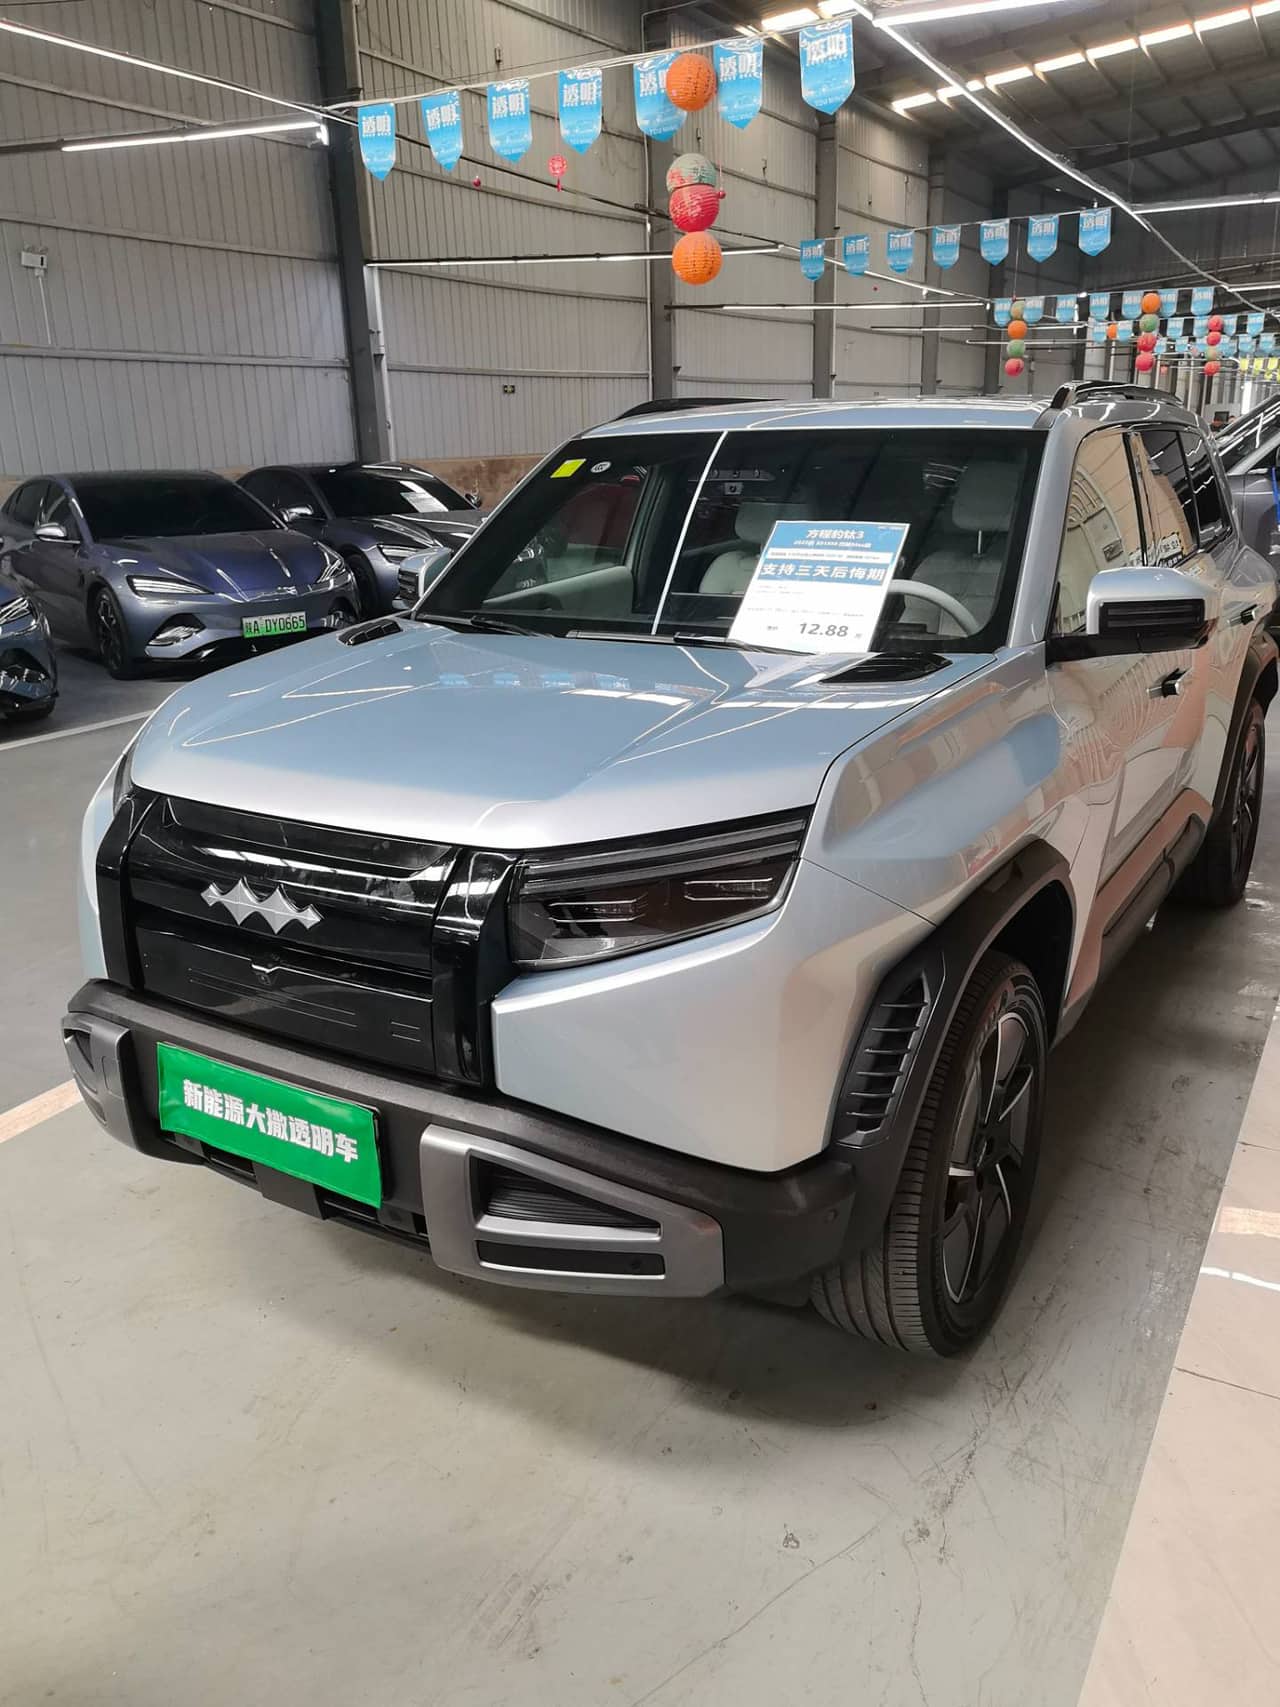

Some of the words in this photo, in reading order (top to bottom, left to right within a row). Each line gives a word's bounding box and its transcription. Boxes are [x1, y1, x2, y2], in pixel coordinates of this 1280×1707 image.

[761, 563, 886, 581] 支持三天后悔期
[800, 622, 849, 637] 12.88
